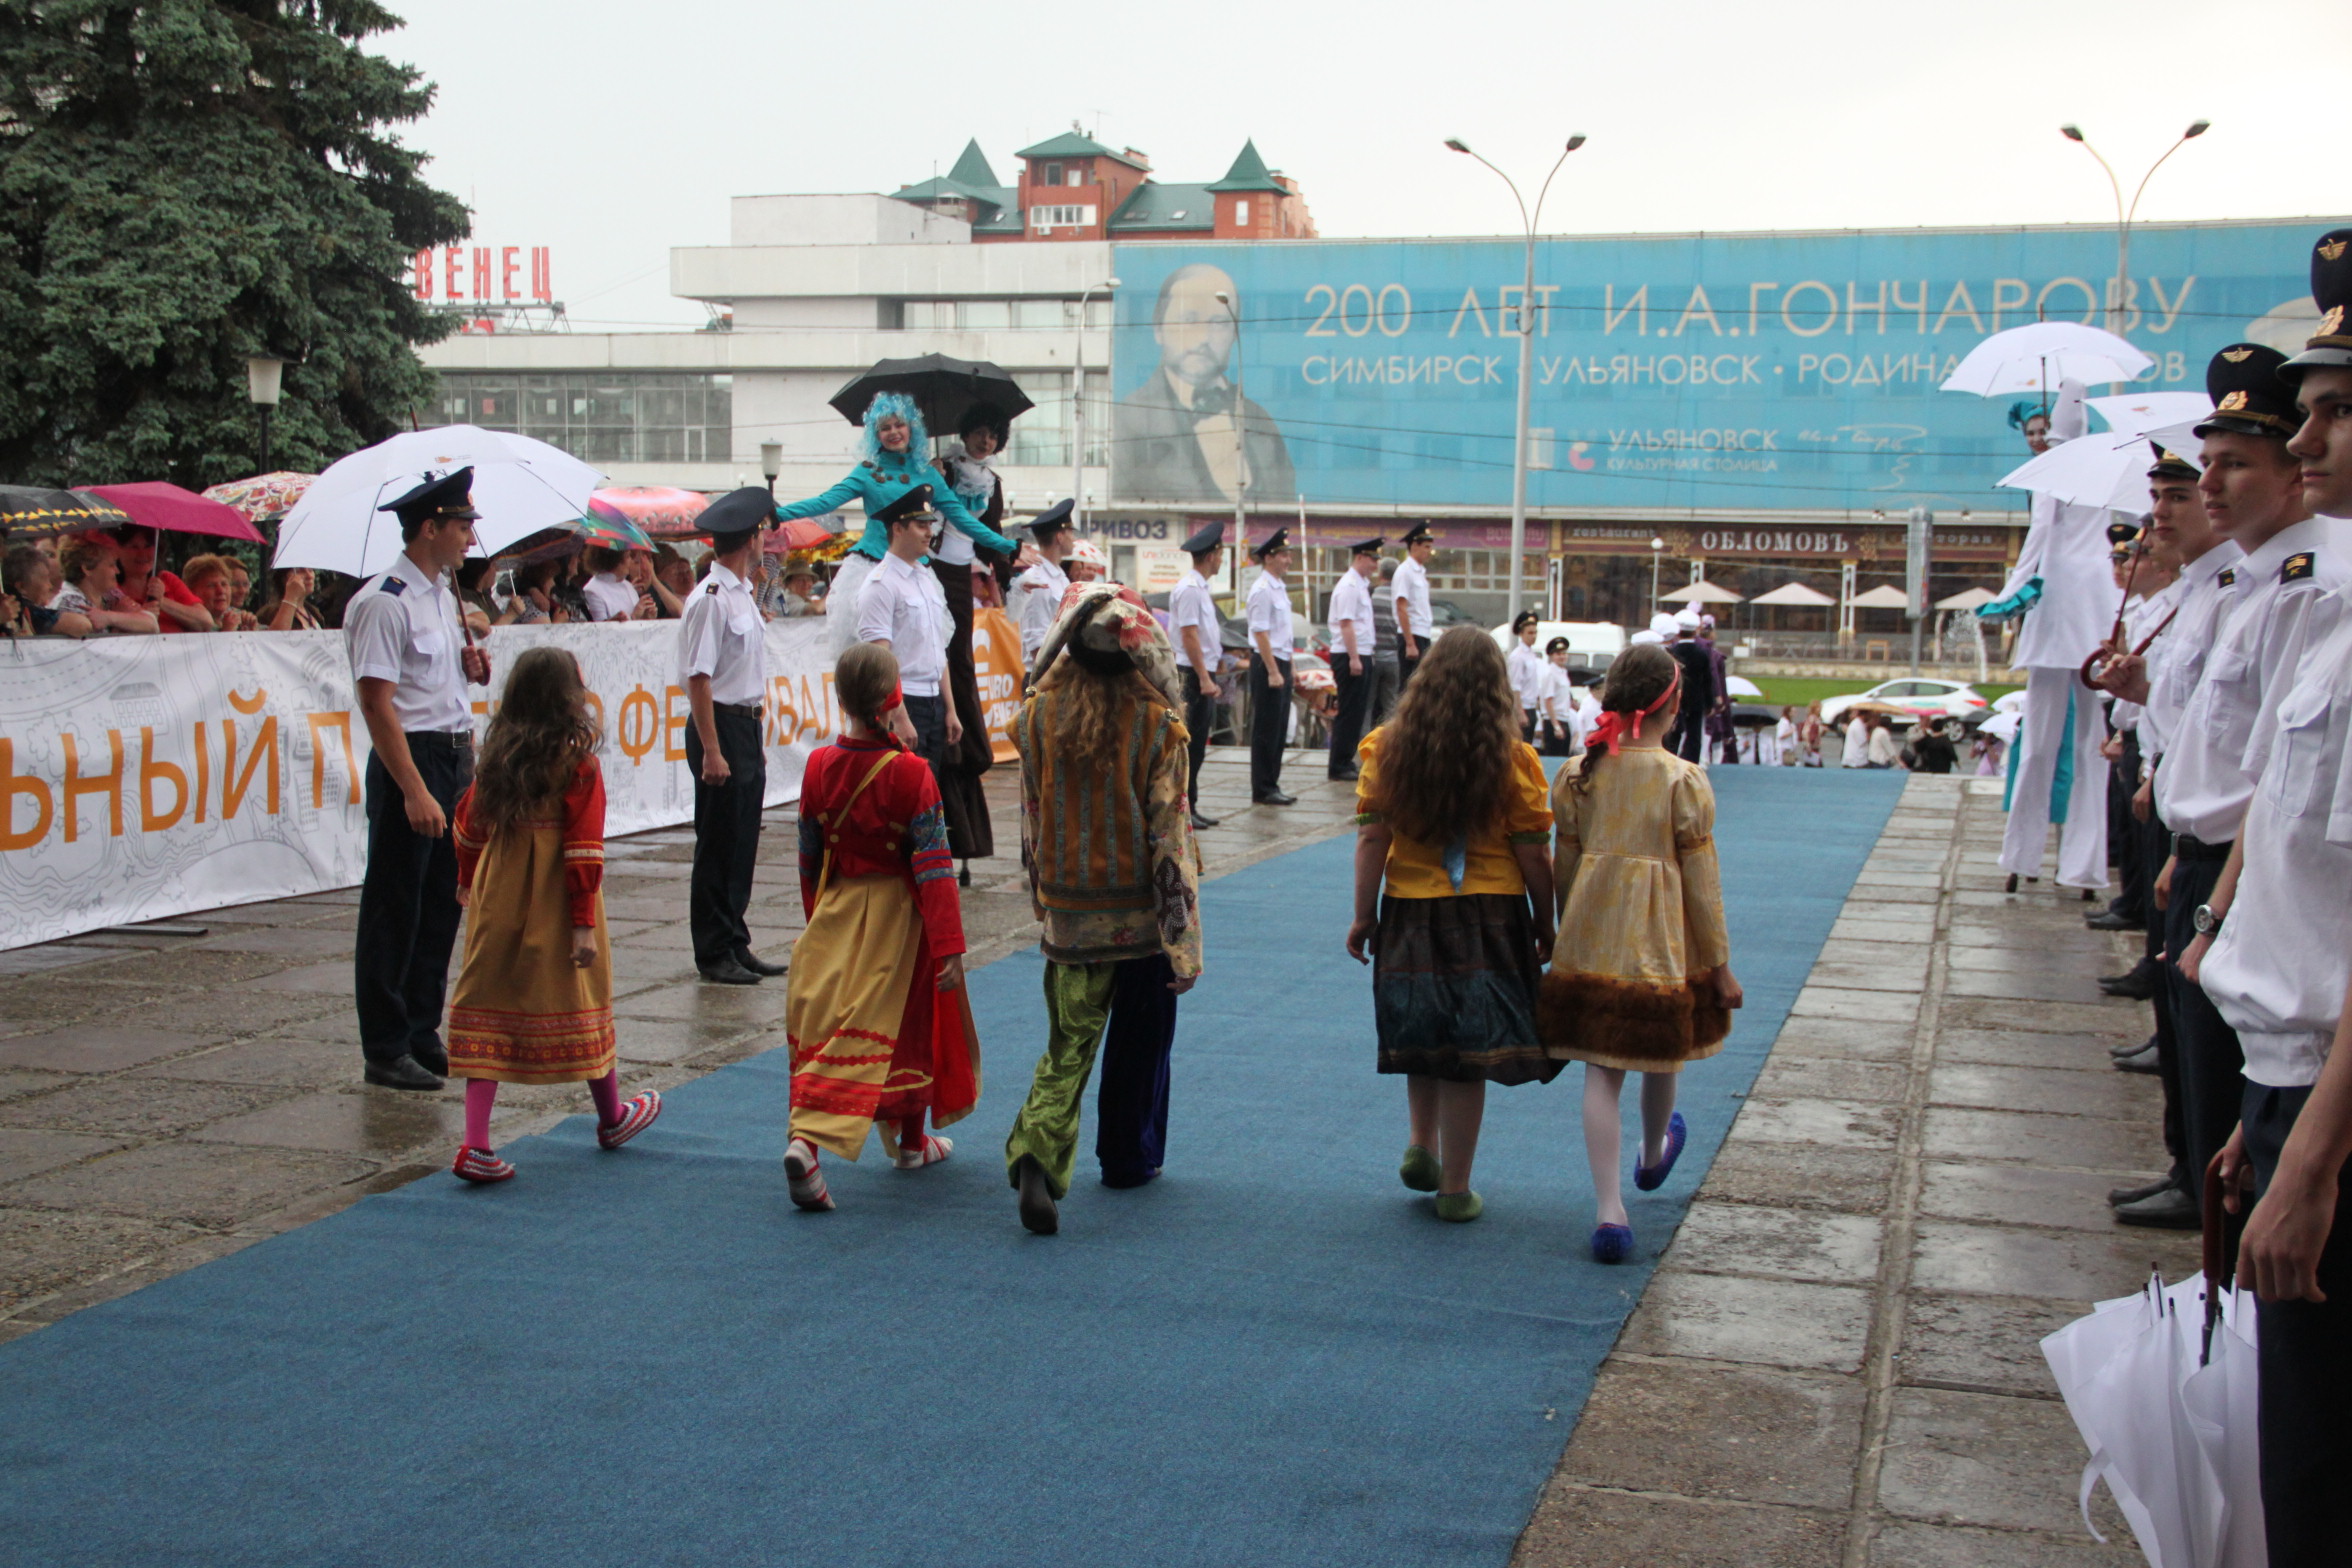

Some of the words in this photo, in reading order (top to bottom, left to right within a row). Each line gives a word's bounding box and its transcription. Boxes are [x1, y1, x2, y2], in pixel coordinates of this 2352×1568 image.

[414, 246, 552, 302] ВЕНЕЦ
[1304, 283, 1412, 338] 200
[1448, 285, 1560, 338] ЛЕТ
[1302, 354, 1503, 386] СИМБИРСК
[1539, 353, 1762, 385] УЛЬЯНОВСК
[1609, 427, 1779, 452] УЛЬЯНОВСК
[1606, 456, 1698, 471] КУЛЬТУРНАЯ
[1702, 457, 1778, 473] СТОЛИЦА
[1573, 528, 1656, 539] restaurant
[1701, 531, 1849, 553] ОБЛОМОВЪ
